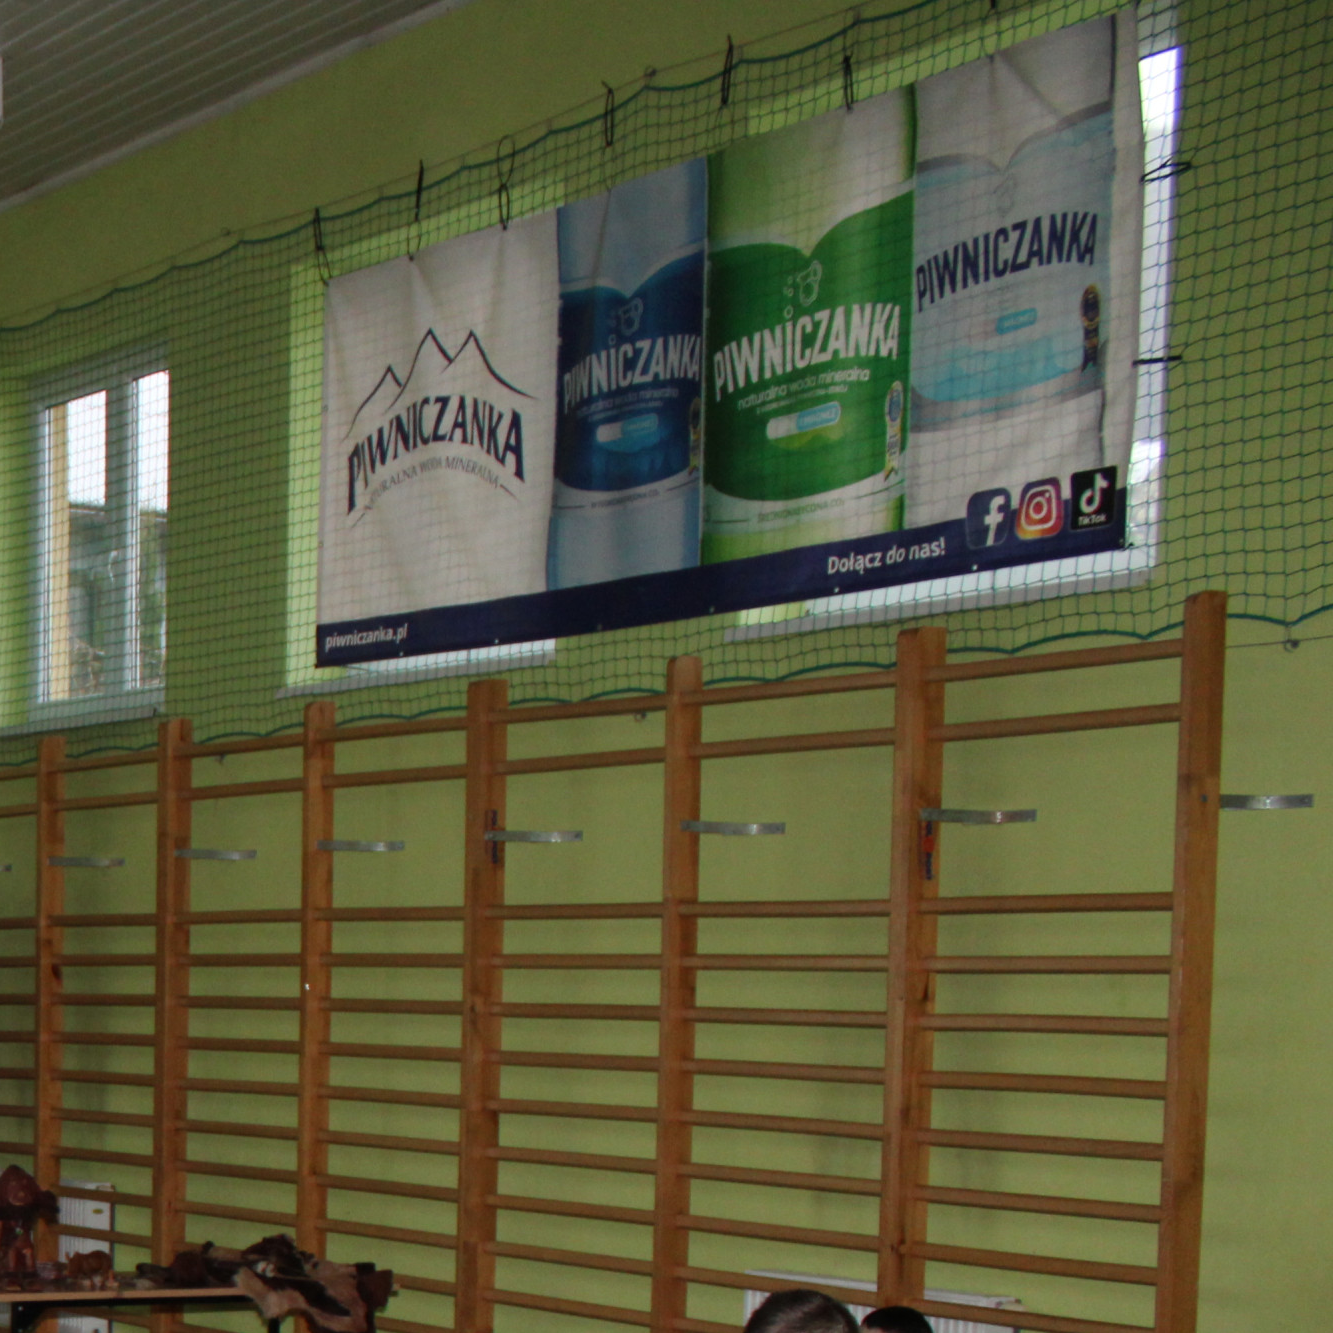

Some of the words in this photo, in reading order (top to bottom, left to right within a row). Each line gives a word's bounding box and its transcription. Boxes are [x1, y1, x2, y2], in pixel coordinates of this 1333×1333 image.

[916, 211, 1098, 313] PIWNICZANKA
[563, 333, 702, 415] PIWNICZANKA
[713, 302, 901, 402] PIWNICZANKA
[347, 394, 526, 516] PIWNICZANKA
[364, 464, 419, 511] ATURALNA
[1078, 513, 1108, 526] TikTok
[827, 548, 883, 575] Dołącz
[886, 545, 906, 565] do
[908, 537, 946, 562] nas!
[324, 622, 409, 653] piwniczanka.pl
